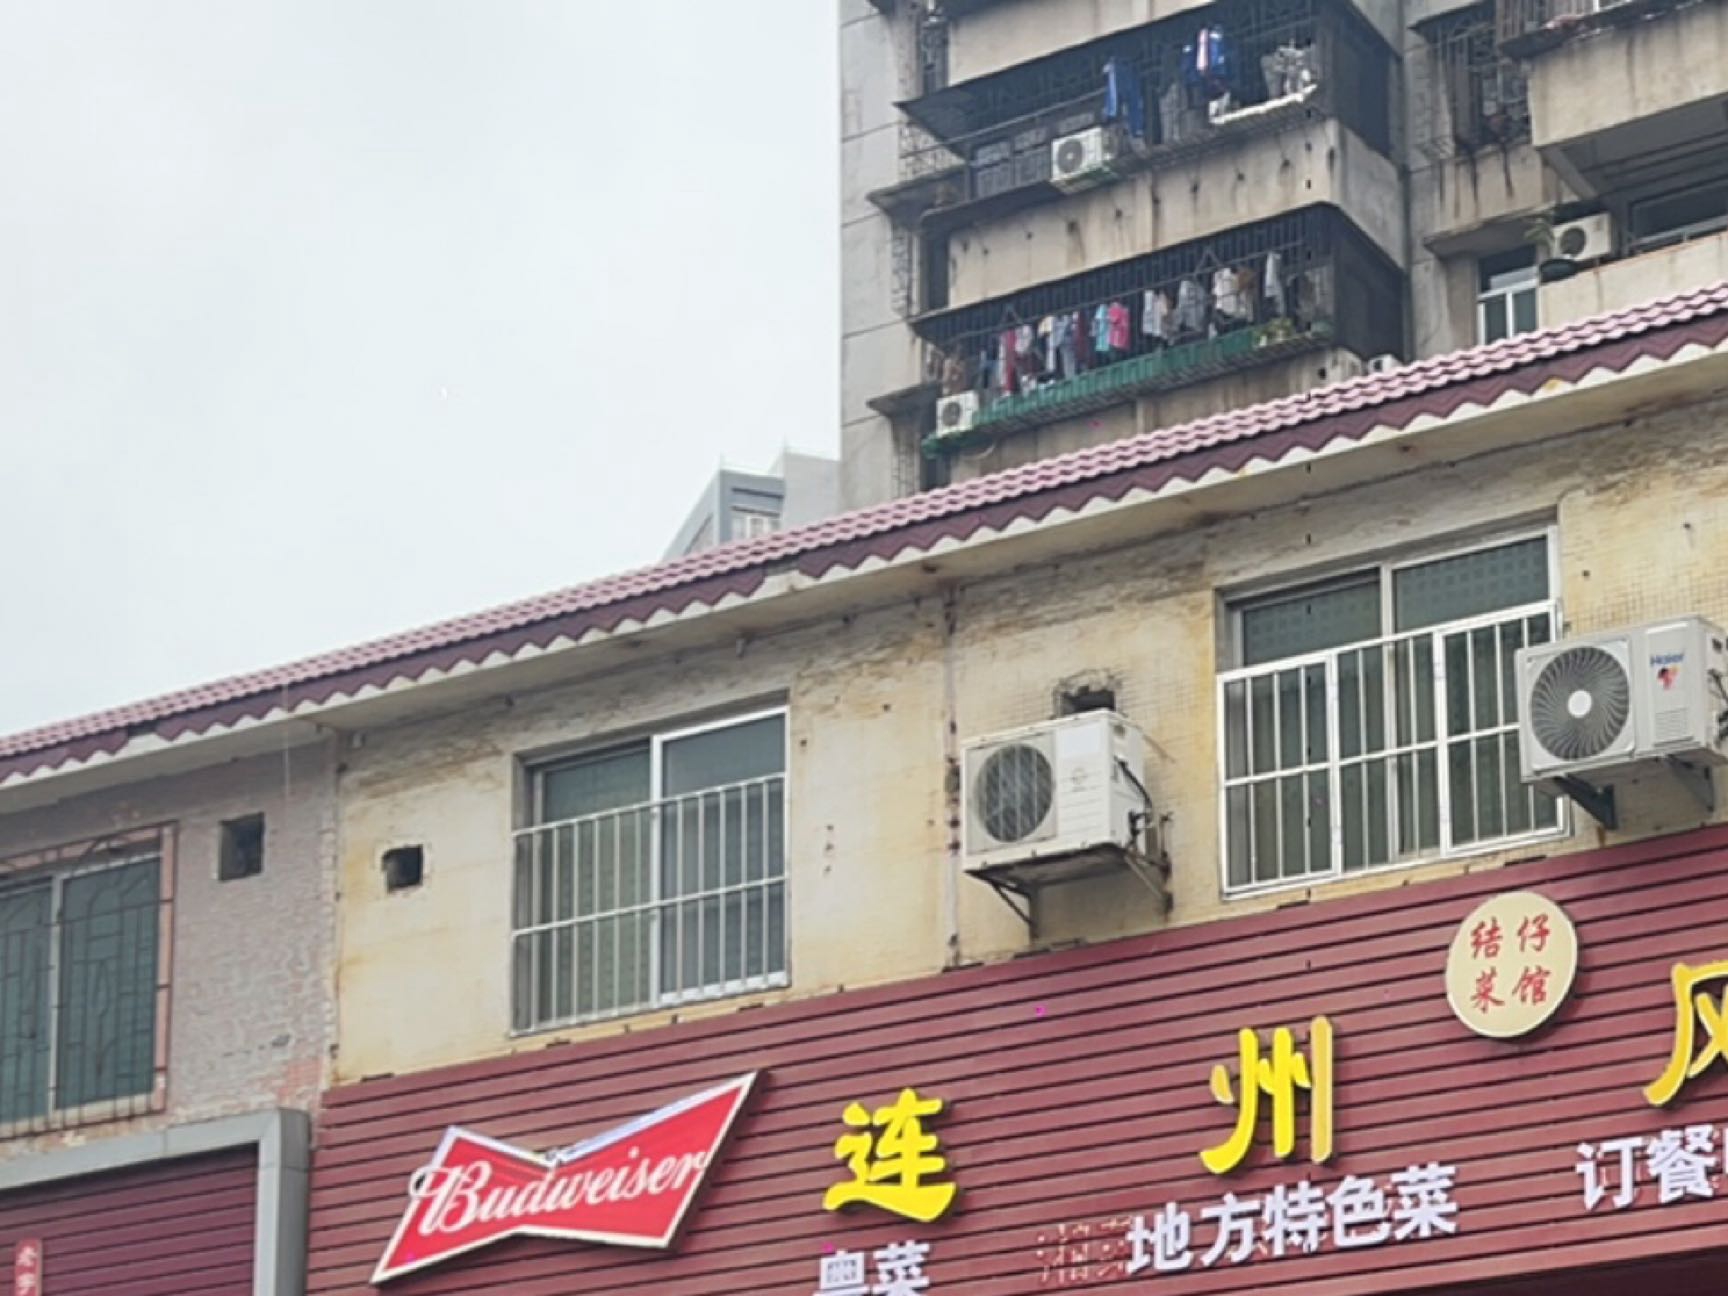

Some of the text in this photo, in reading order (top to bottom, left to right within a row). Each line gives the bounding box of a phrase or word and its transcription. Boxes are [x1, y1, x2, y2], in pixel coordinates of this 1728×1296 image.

[1470, 966, 1551, 1014] 菜馆
[409, 1146, 708, 1235] Budweiser
[1125, 1161, 1459, 1275] 地方特色菜
